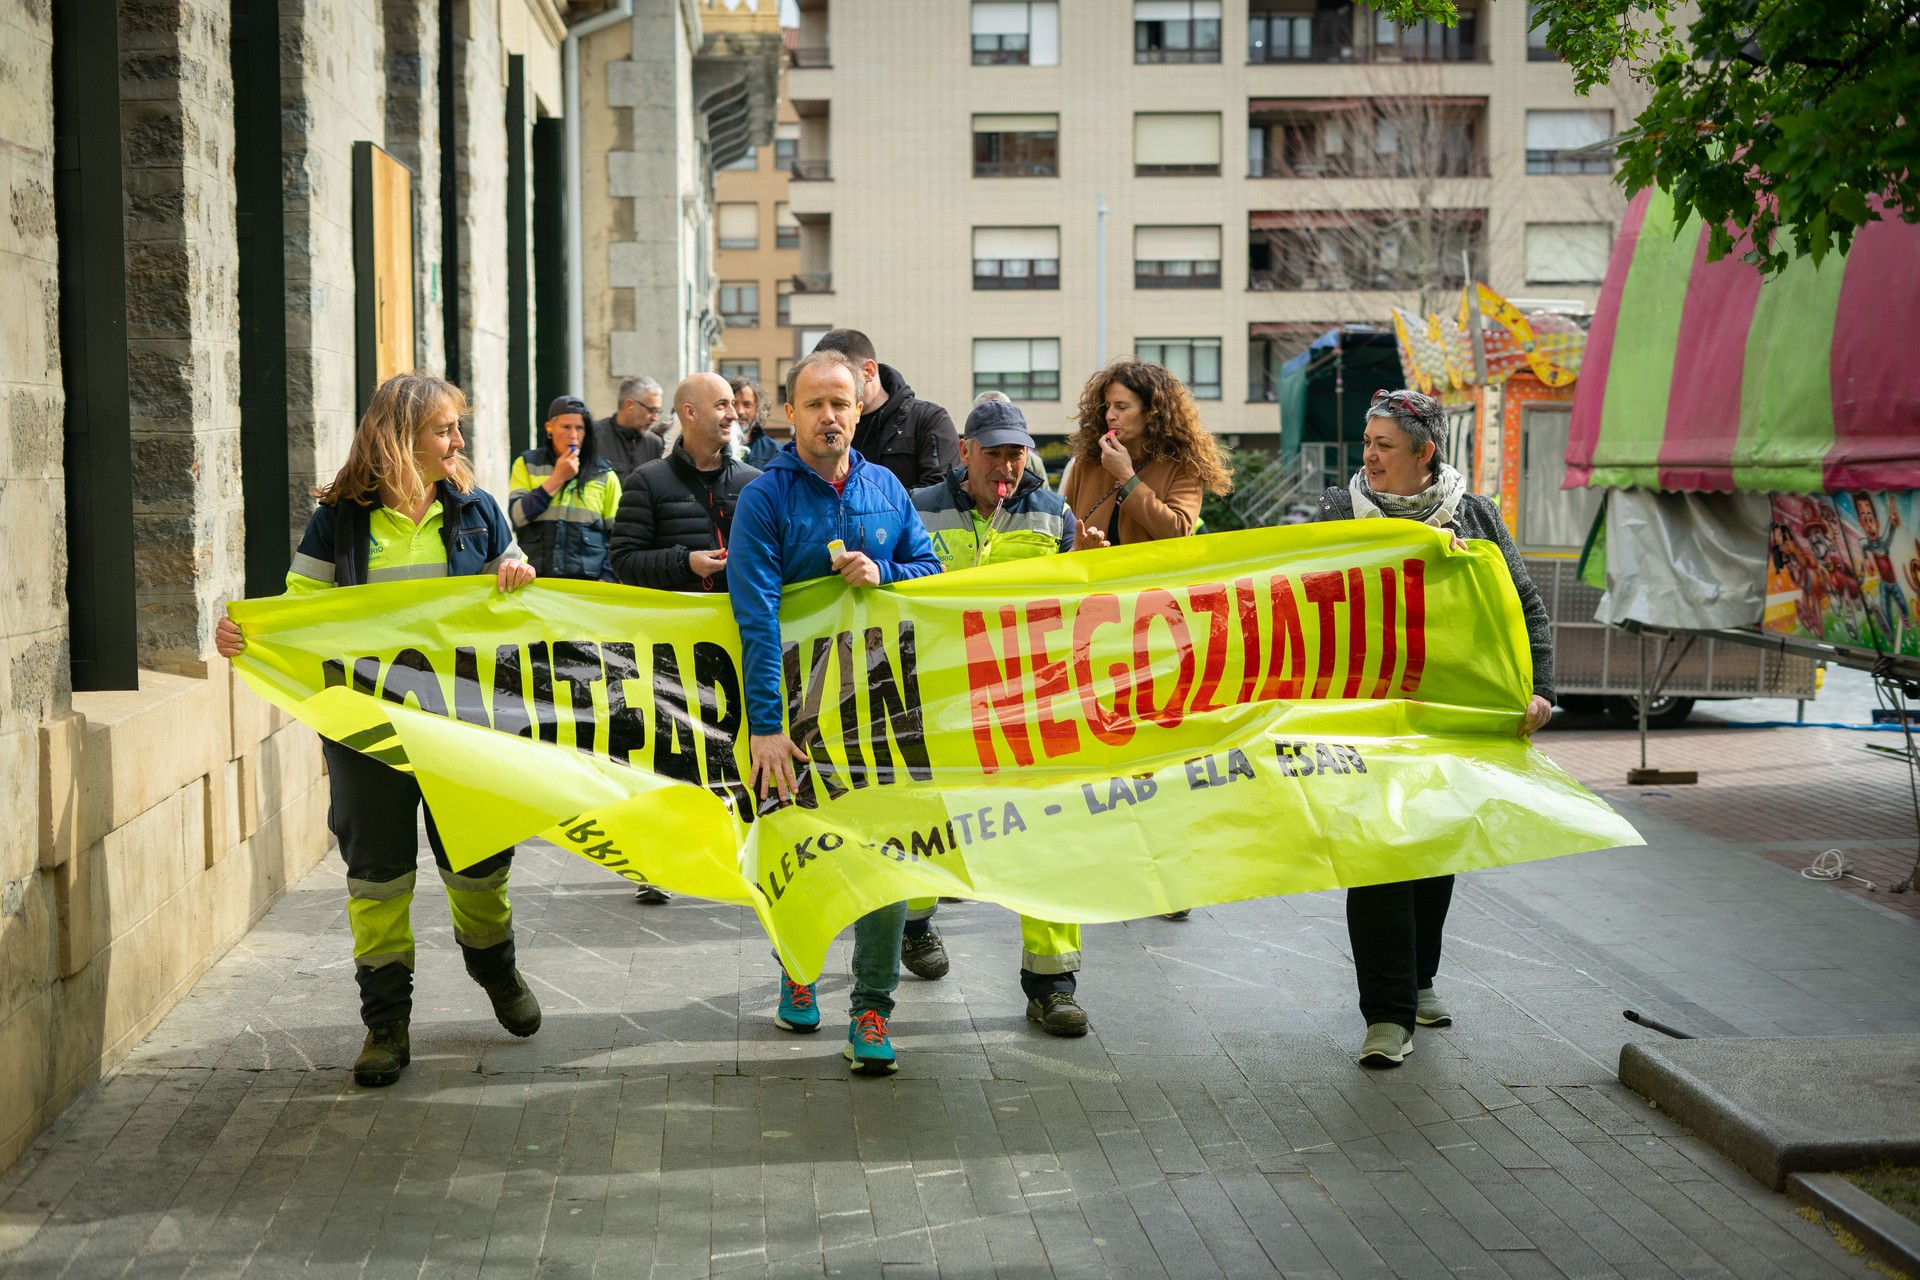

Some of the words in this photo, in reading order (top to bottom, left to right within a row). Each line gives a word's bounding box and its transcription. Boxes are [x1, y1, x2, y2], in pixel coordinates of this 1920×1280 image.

[860, 801, 1027, 863] OMITEA
[1080, 771, 1158, 815] LAB
[1183, 747, 1255, 791] ELA
[1274, 739, 1368, 778] ESAN
